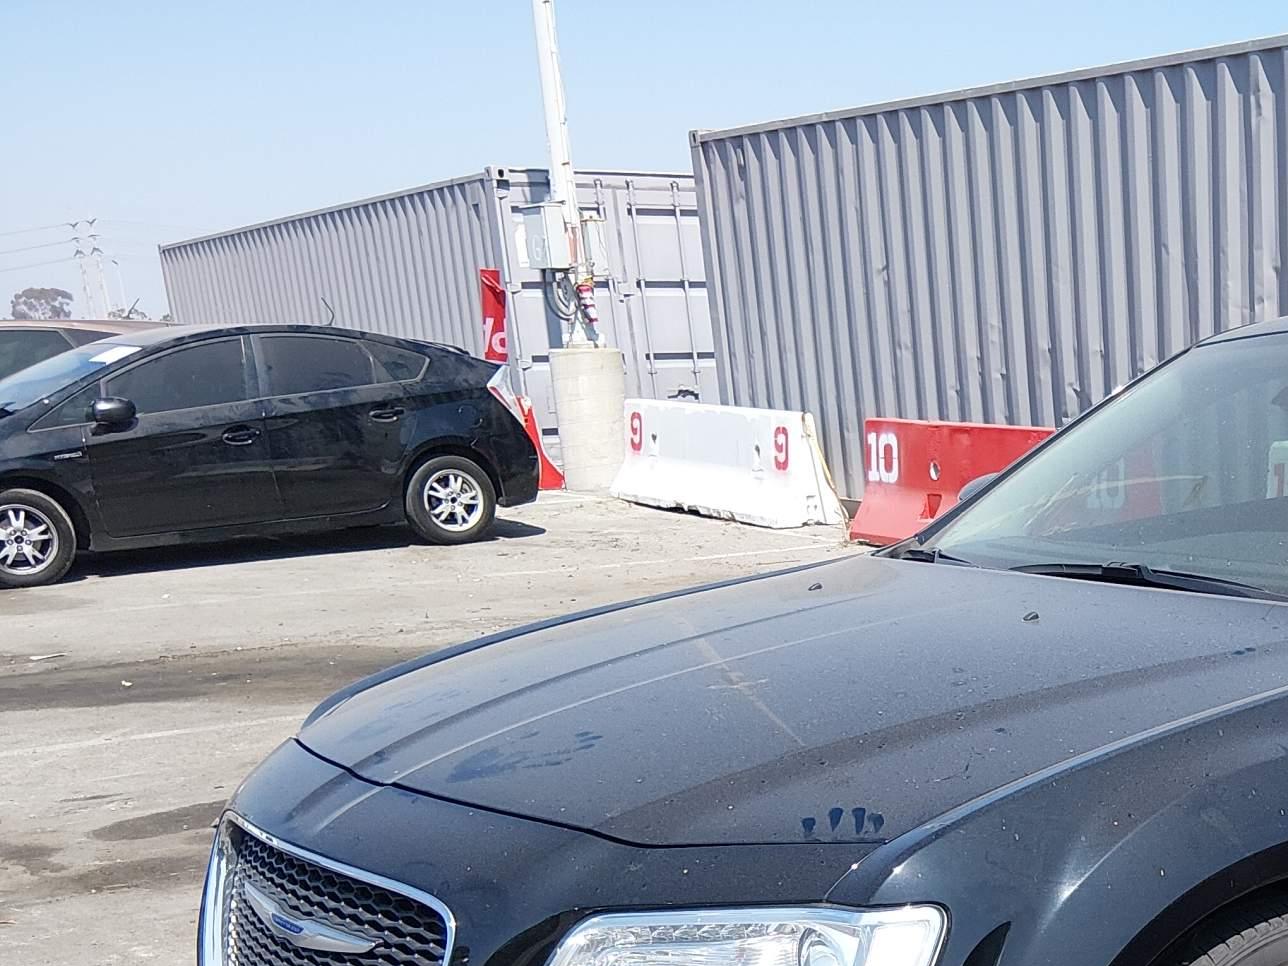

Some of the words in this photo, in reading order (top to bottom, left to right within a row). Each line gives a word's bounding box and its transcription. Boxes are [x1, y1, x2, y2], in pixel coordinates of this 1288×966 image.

[629, 411, 643, 452] 9
[773, 426, 789, 471] 9
[867, 432, 899, 484] 10
